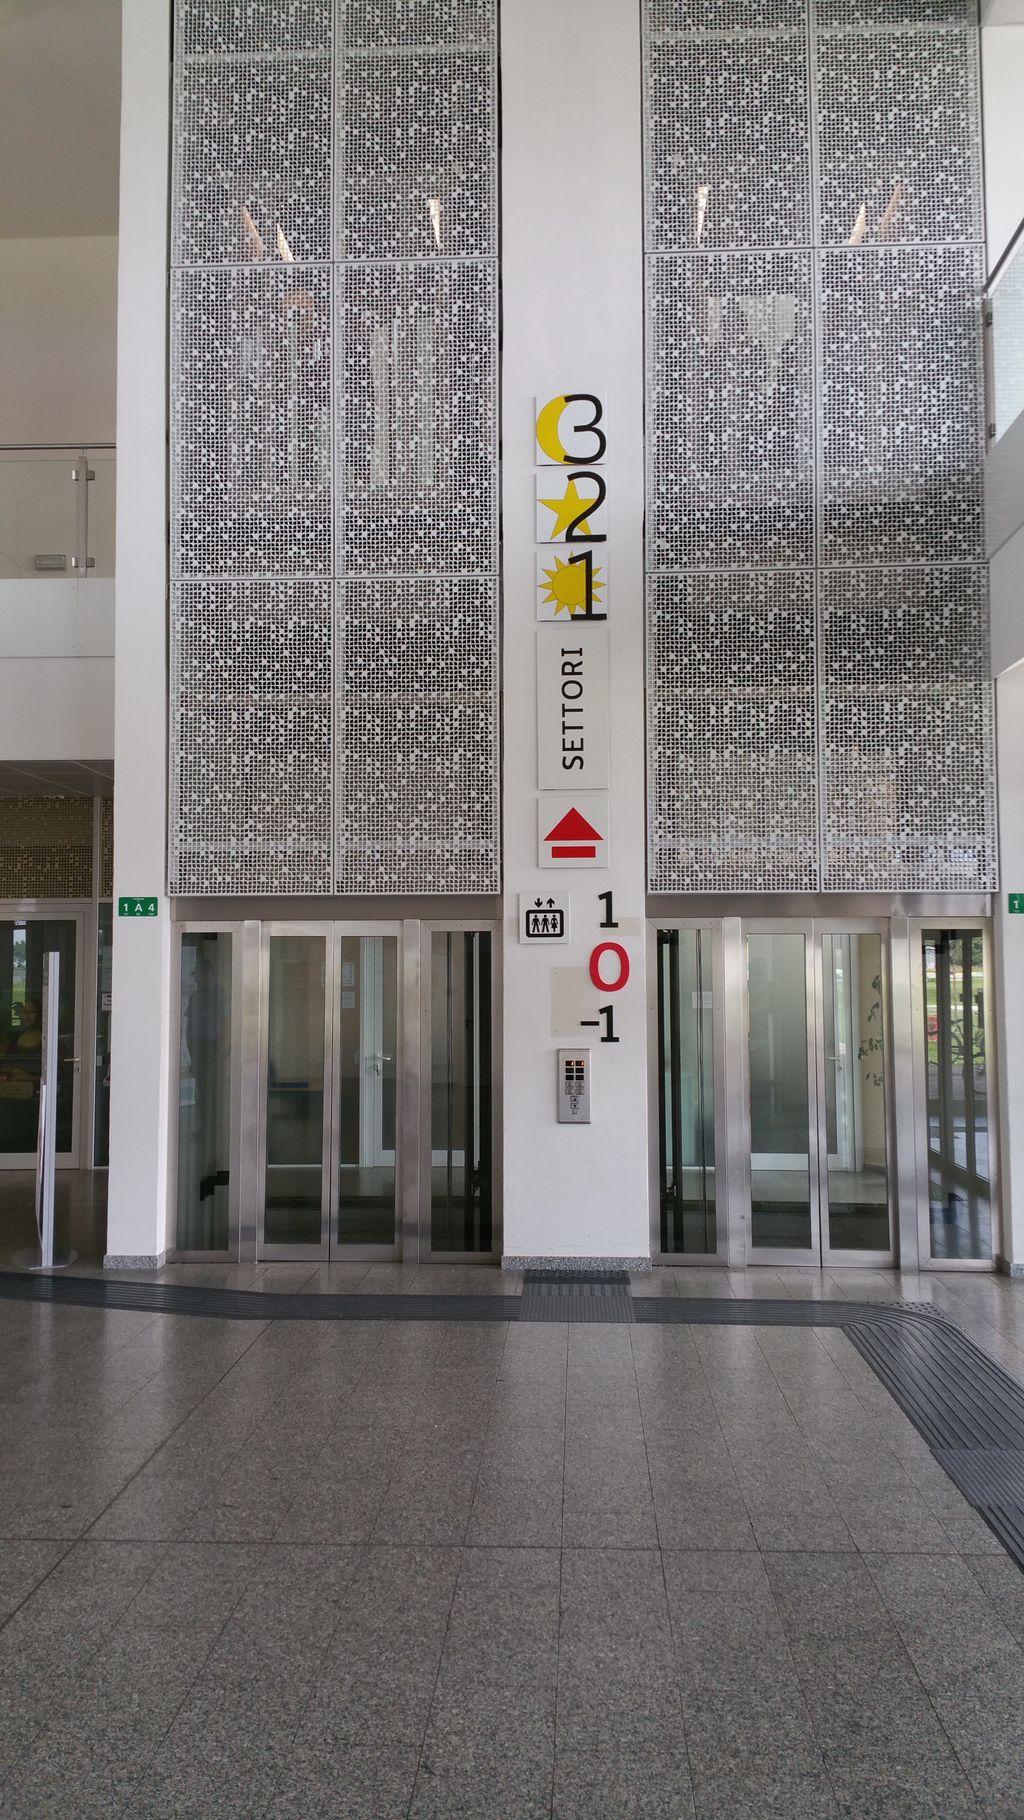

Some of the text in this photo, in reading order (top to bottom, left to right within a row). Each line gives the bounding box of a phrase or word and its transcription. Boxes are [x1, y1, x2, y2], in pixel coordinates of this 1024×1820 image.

[563, 393, 607, 464] 3
[564, 471, 607, 543] 2
[567, 549, 607, 621] 1
[561, 647, 584, 770] SETTORI
[123, 903, 155, 912] 1 A 4
[598, 890, 619, 929] 1
[1013, 900, 1019, 909] 1
[589, 941, 630, 992] 0
[580, 1004, 620, 1043] -1
